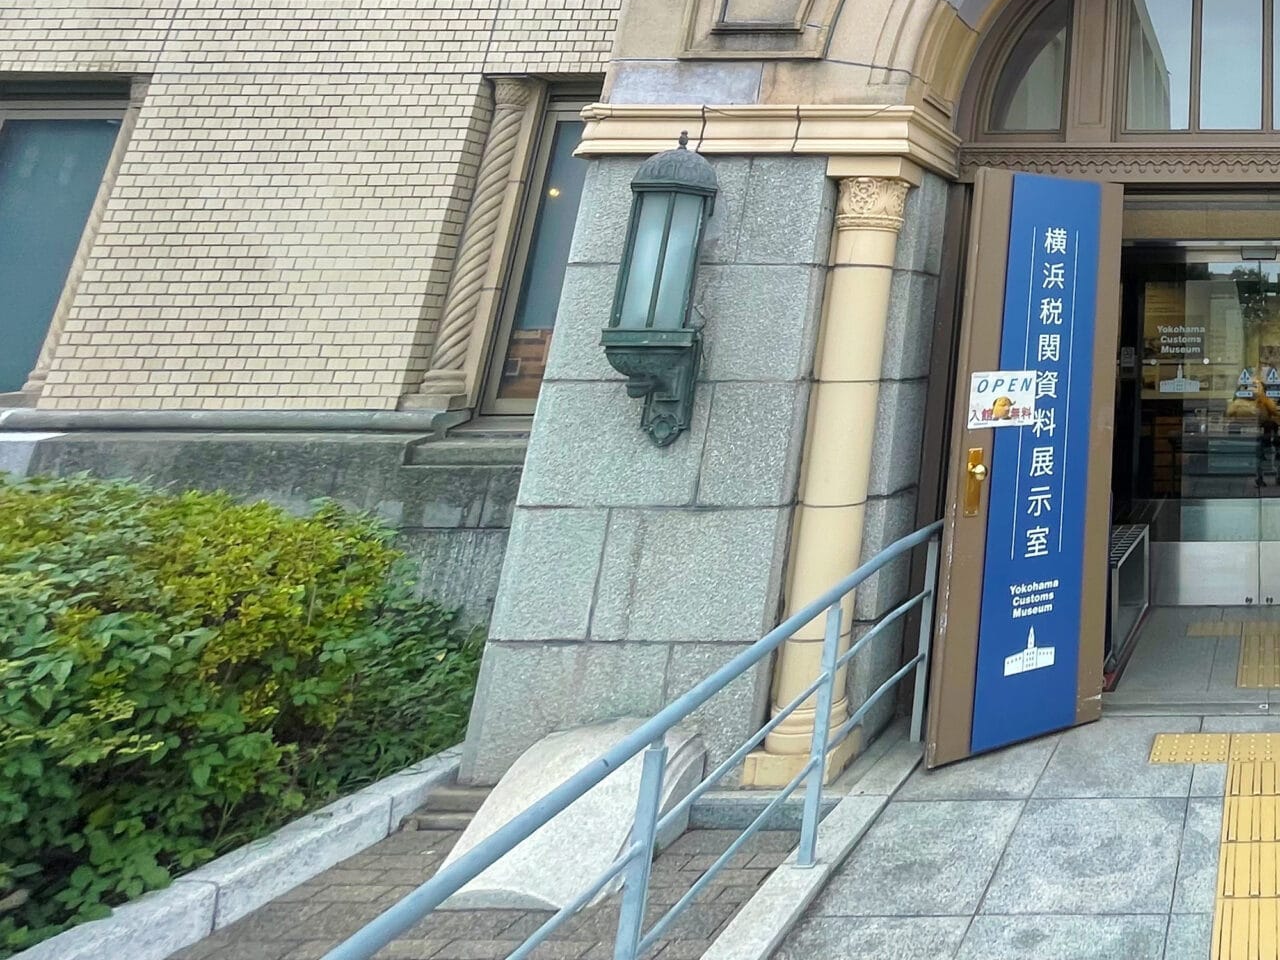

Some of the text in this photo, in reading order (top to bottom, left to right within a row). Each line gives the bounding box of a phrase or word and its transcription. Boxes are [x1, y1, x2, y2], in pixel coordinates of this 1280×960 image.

[1157, 325, 1206, 333] Yokohama
[1160, 335, 1202, 344] Customs
[1160, 345, 1201, 354] Museum
[976, 378, 1033, 394] OPEN
[1024, 227, 1067, 558] 横浜税関資料展示室
[1009, 579, 1060, 596] Yokohama
[1012, 591, 1055, 607] Customs
[1012, 603, 1053, 619] Museum
